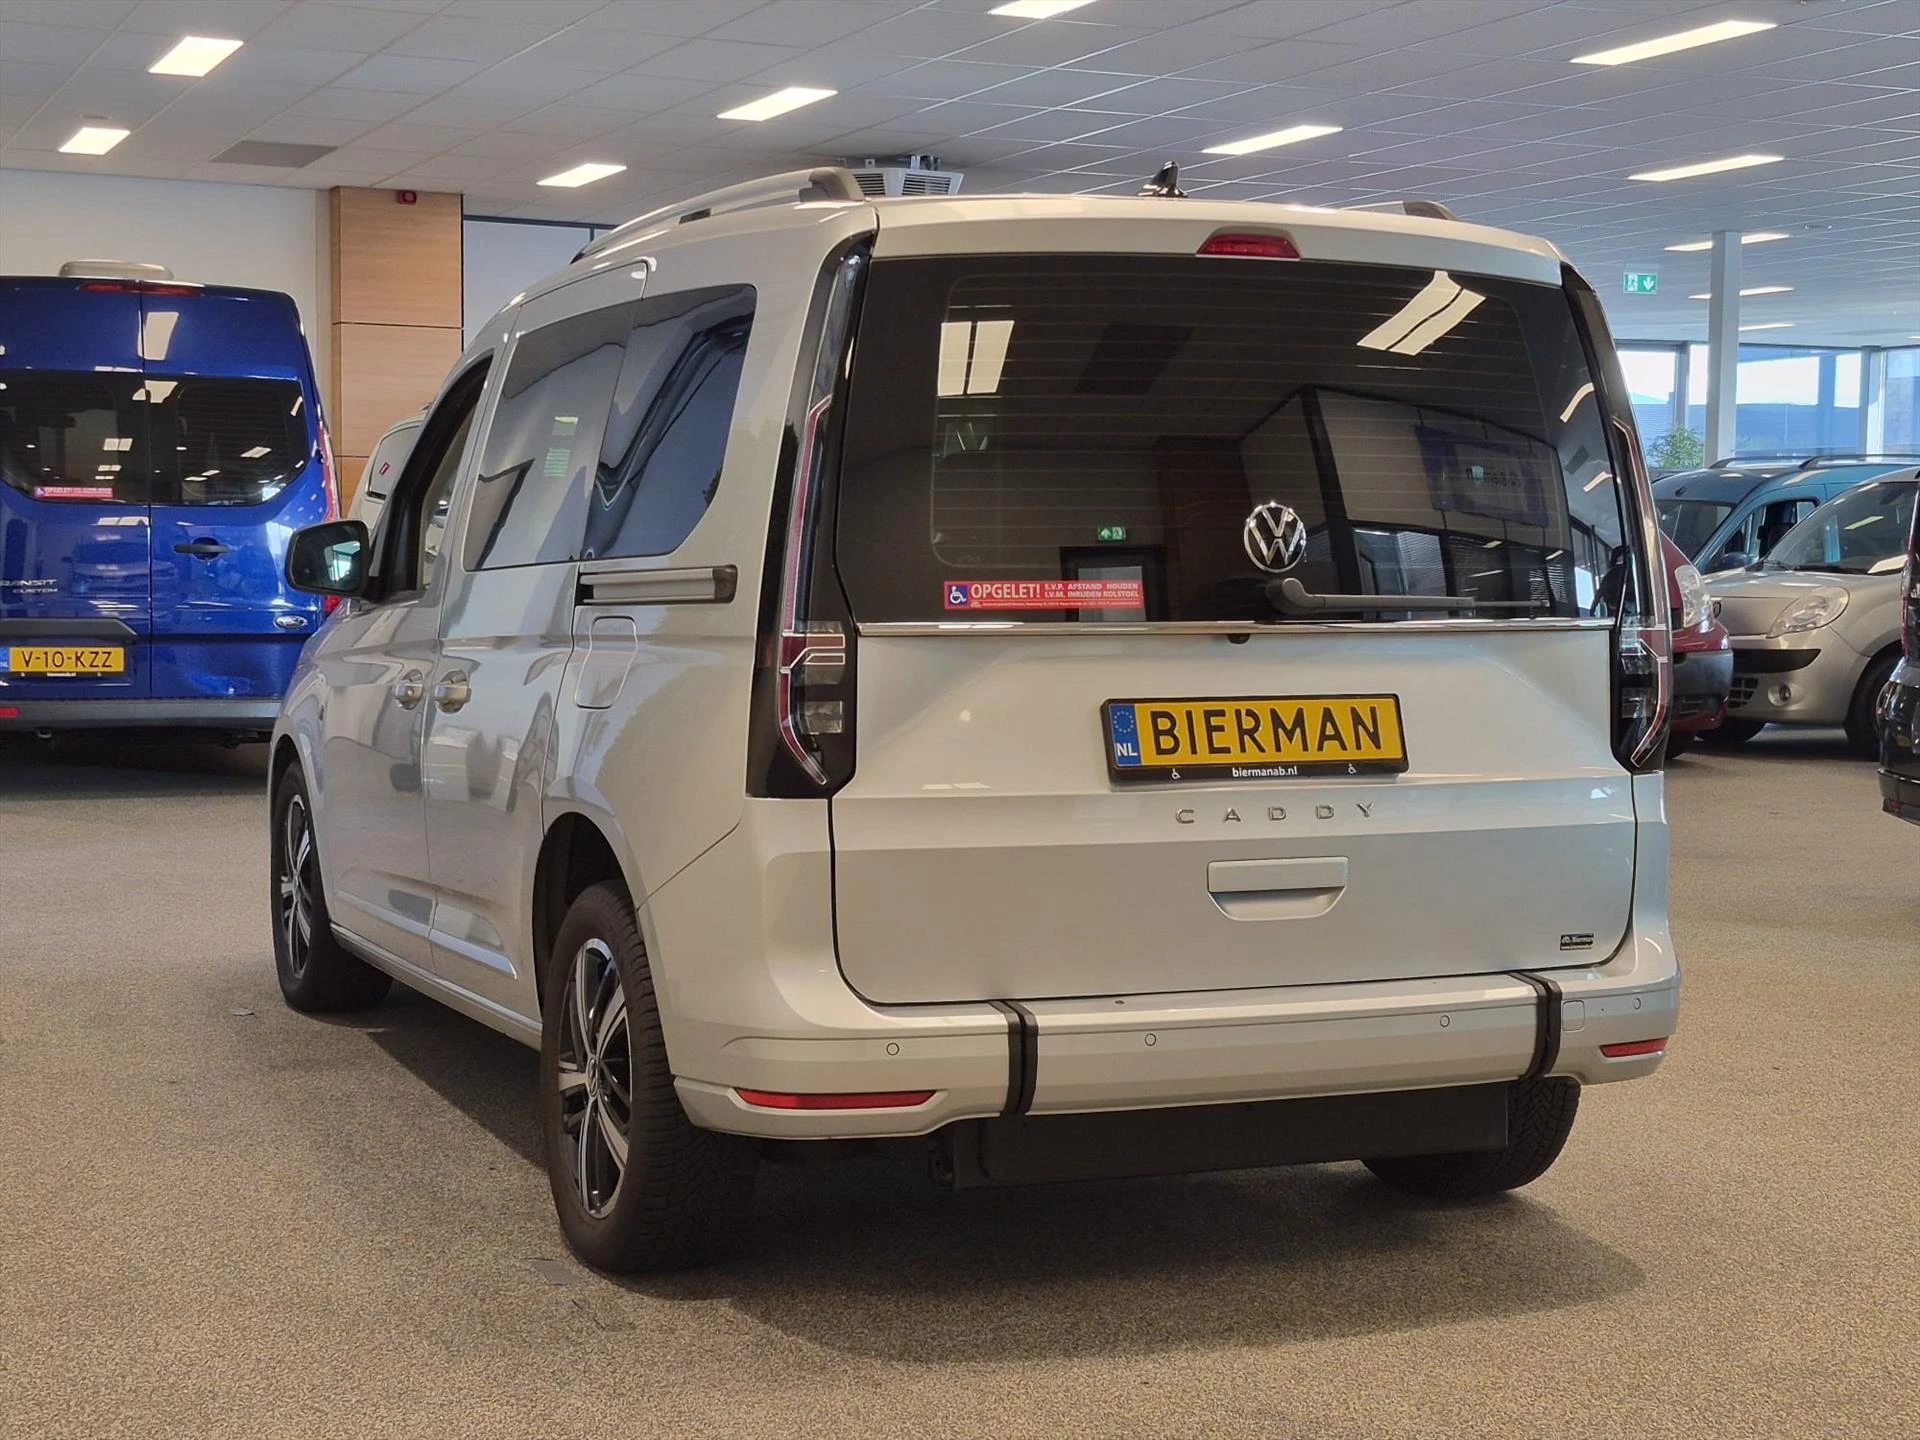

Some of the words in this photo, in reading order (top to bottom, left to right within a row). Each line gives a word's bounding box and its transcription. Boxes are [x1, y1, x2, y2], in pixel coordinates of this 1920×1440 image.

[0, 579, 57, 587] RANSIT
[970, 583, 1041, 599] OPGELET!
[21, 650, 113, 668] V-10-KZZ
[1116, 742, 1138, 756] NL
[1150, 705, 1383, 756] BIERMAN
[1232, 766, 1298, 778] biermanab.nl
[1175, 802, 1375, 825] CADDY
